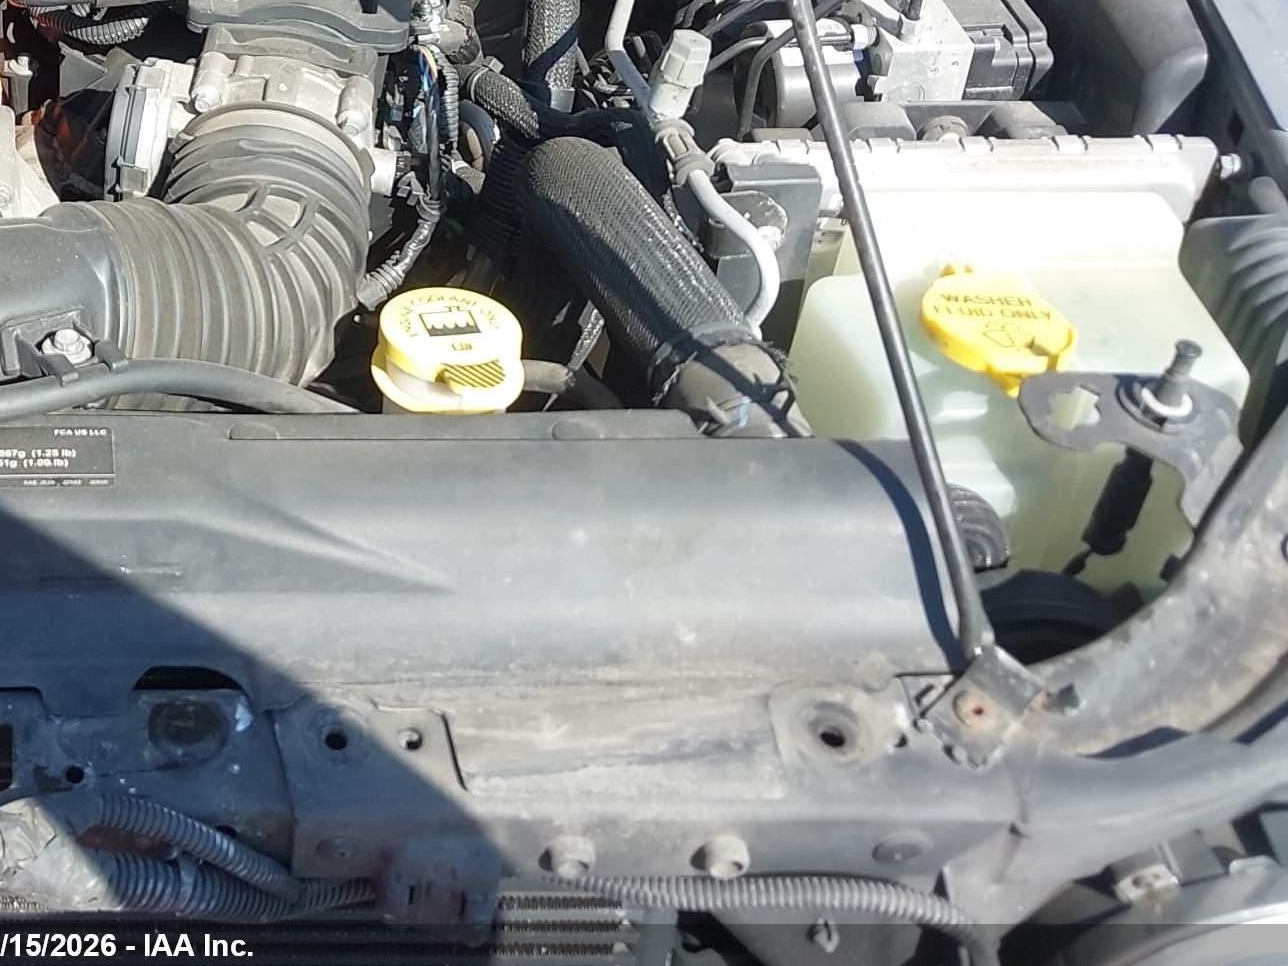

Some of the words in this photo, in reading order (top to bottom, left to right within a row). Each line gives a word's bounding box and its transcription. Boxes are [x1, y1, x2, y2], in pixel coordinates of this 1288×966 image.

[940, 293, 1032, 307] WASHER
[933, 304, 993, 317] FLUID
[1000, 308, 1051, 320] ONLY
[53, 428, 73, 436] FCA
[74, 428, 87, 436] US
[88, 428, 107, 436] LLC
[31, 448, 60, 458] (1.25
[61, 448, 77, 458] lb)
